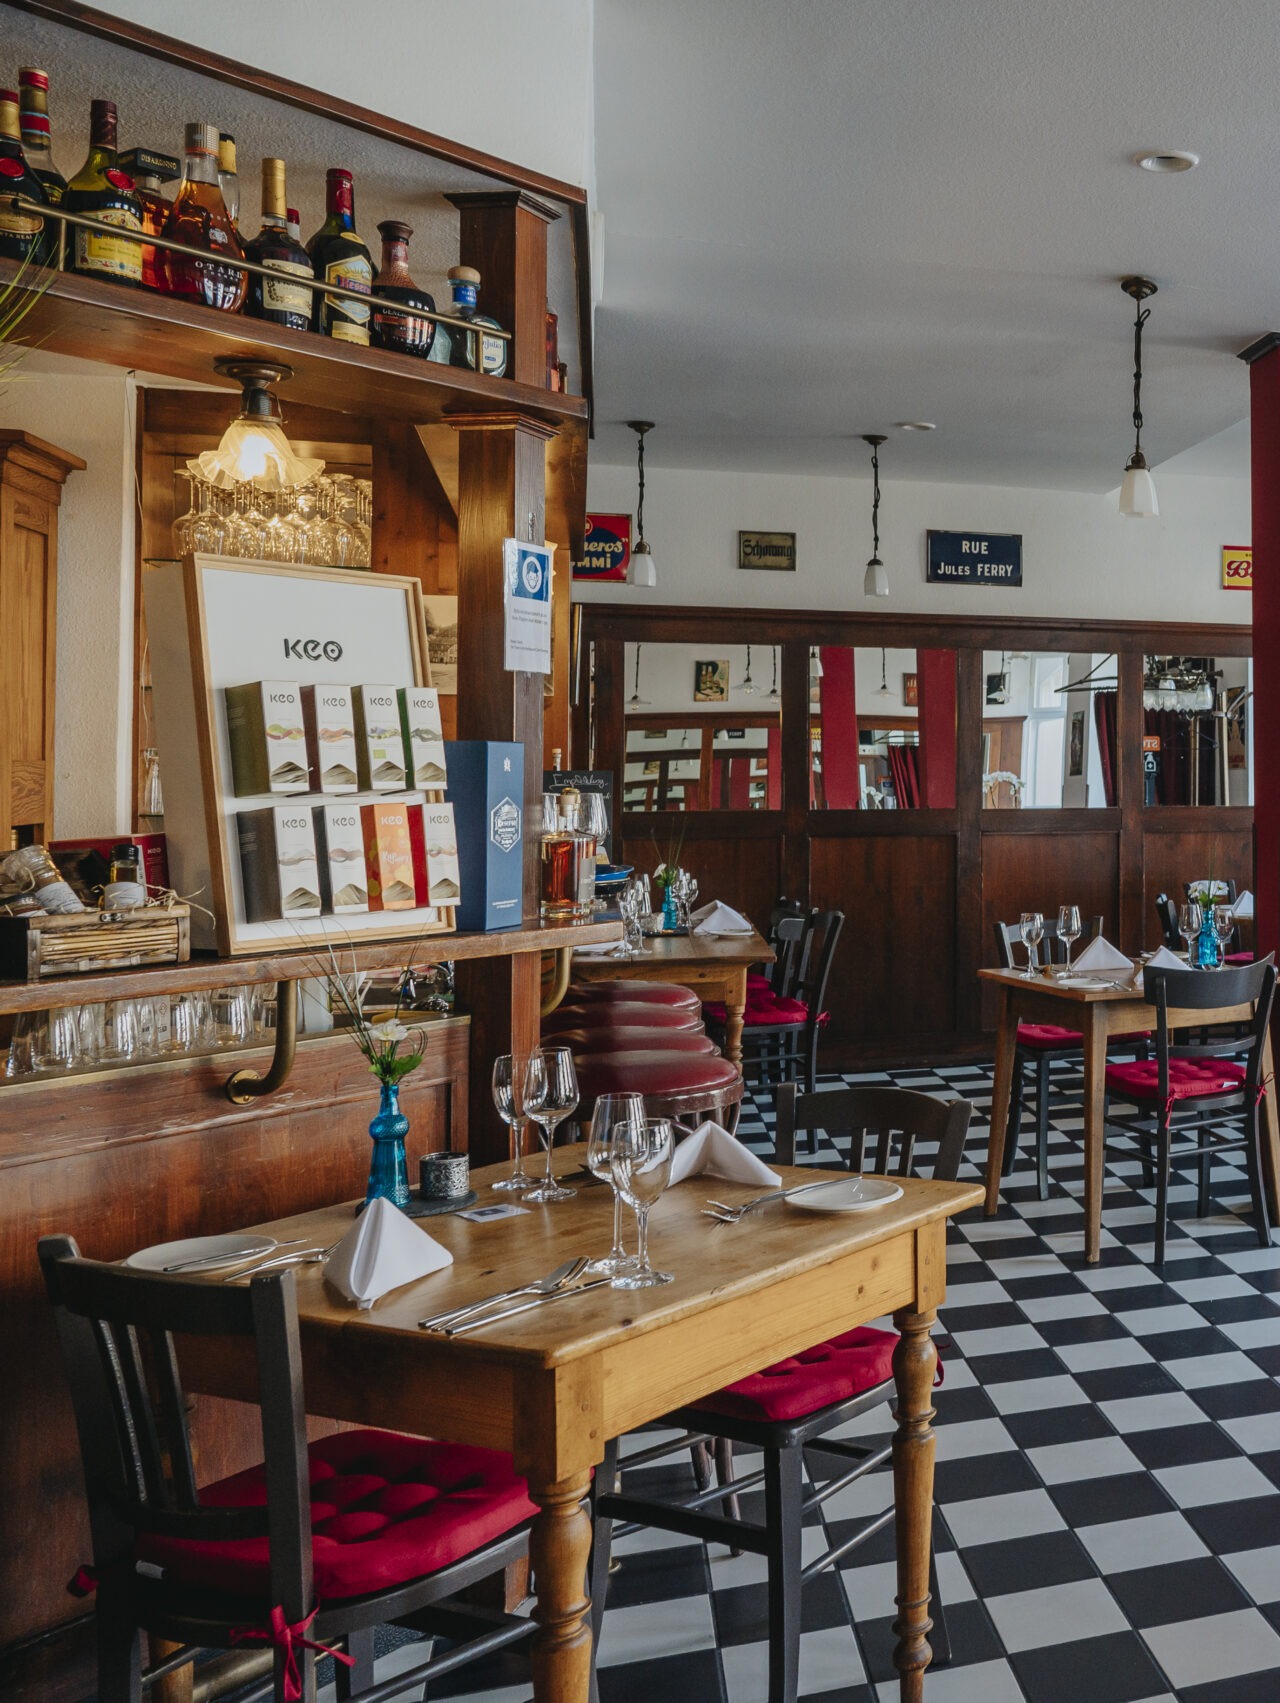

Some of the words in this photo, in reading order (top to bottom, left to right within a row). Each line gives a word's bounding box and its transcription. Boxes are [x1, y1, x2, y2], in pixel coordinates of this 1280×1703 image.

[195, 261, 243, 280] OTARD
[962, 540, 989, 555] RUE
[977, 563, 1013, 577] FERRY
